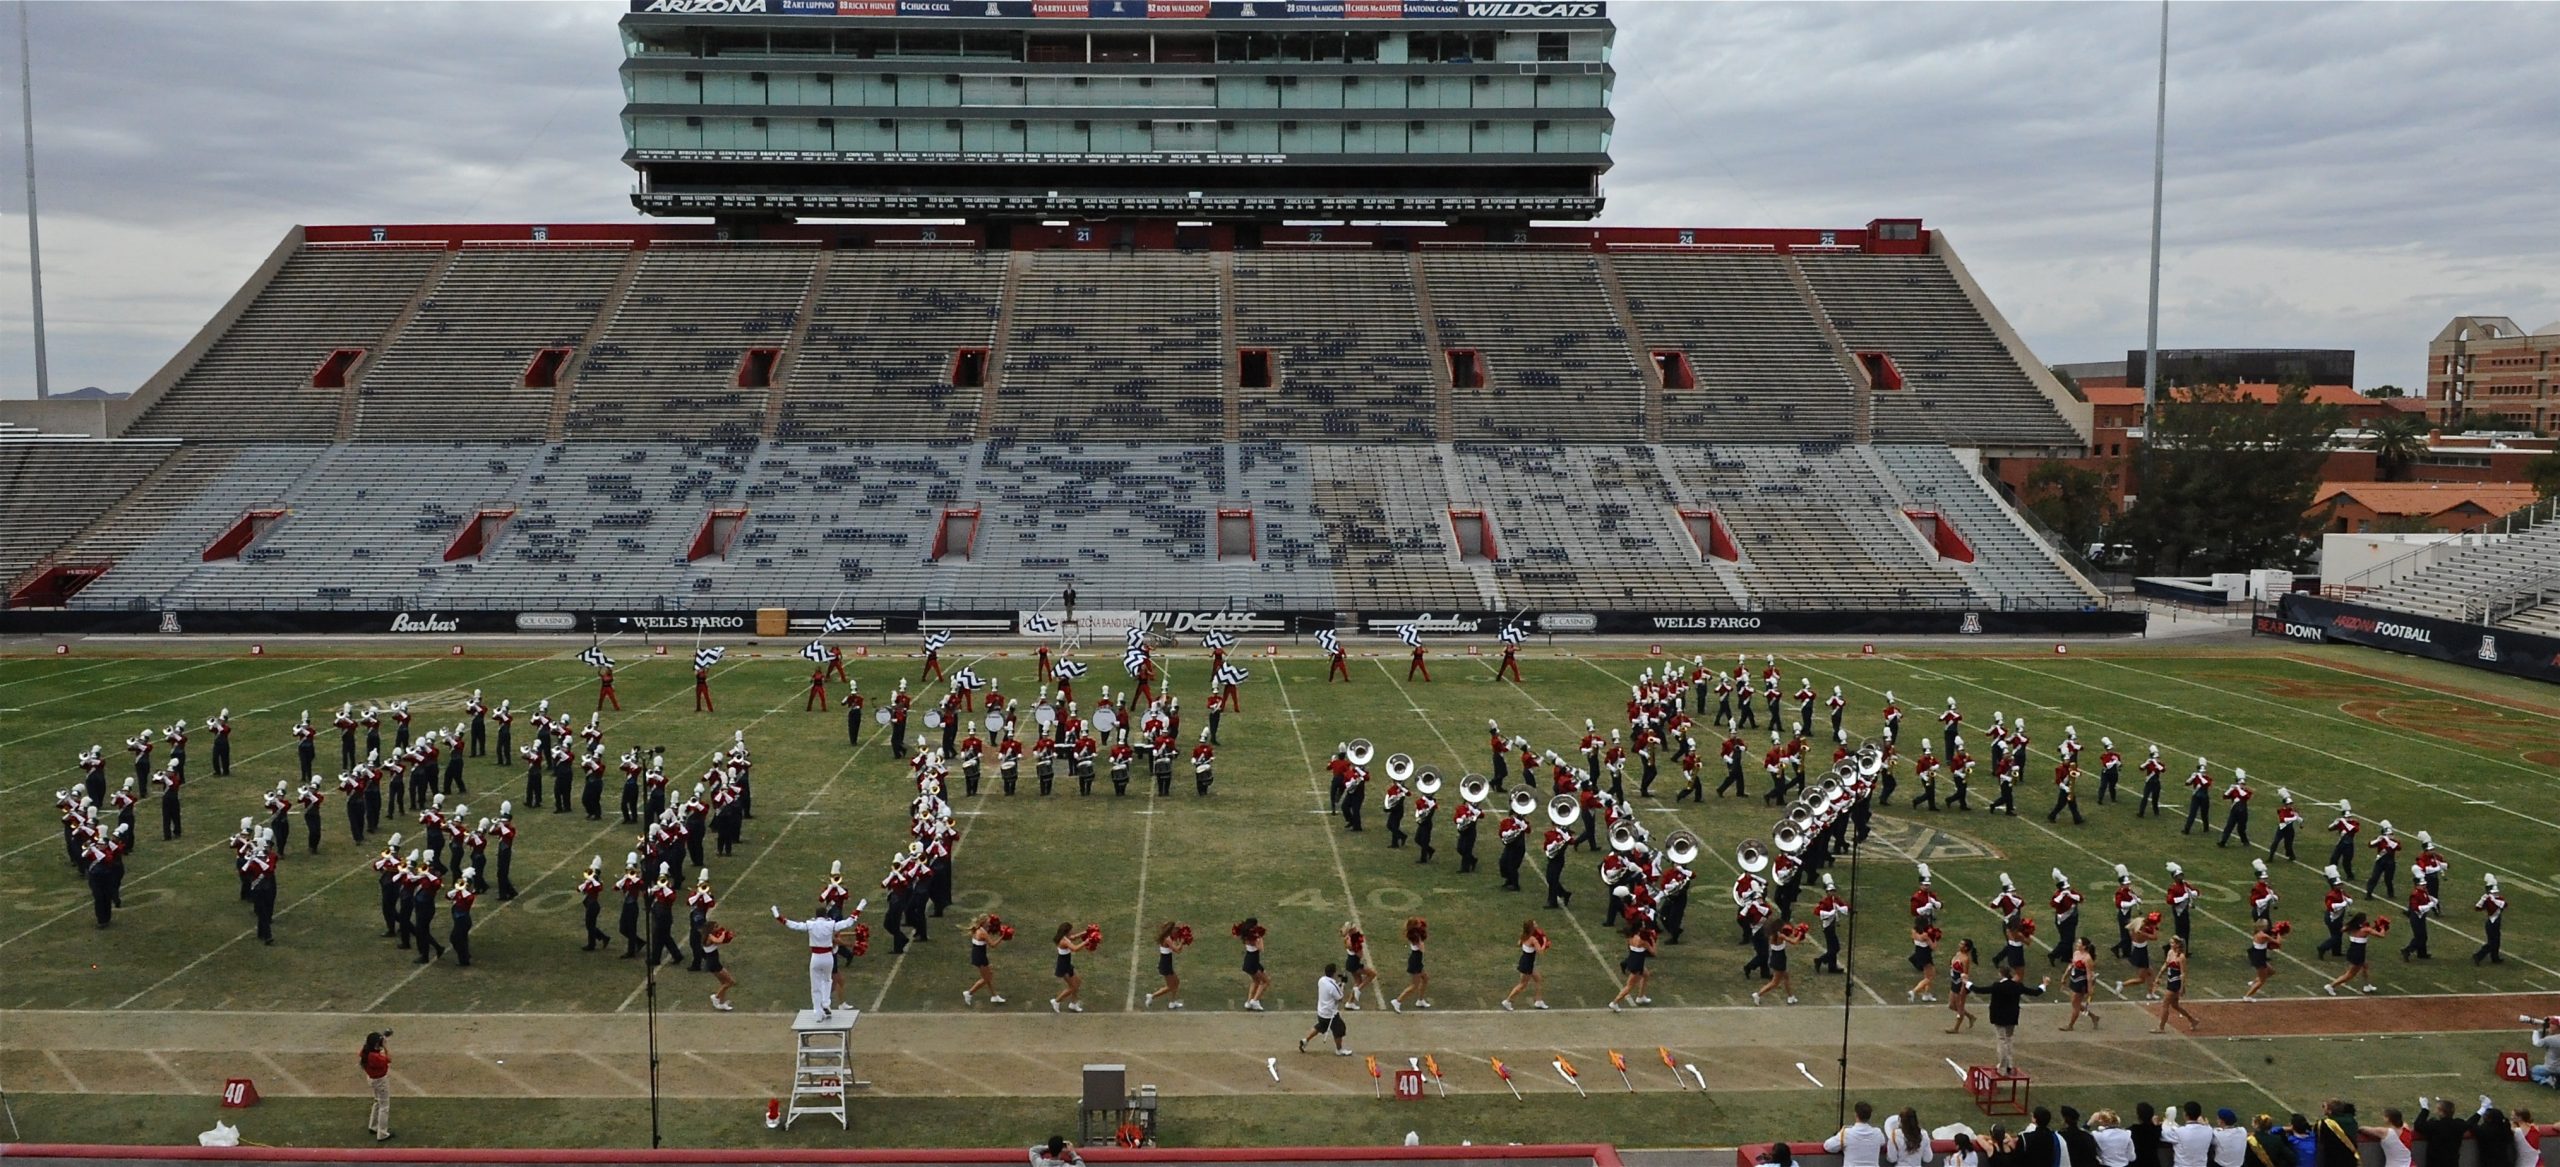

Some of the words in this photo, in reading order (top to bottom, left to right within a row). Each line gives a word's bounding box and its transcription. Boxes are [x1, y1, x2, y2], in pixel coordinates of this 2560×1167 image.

[645, 0, 766, 13] ARIZONA
[792, 1, 806, 9] ART
[806, 1, 835, 9] LUPPINO
[849, 2, 868, 10] RICKY
[870, 2, 896, 10] HUNLEY
[907, 2, 931, 11] CHUCK
[931, 3, 950, 11] CECIL
[1038, 4, 1068, 12] DARRYLL
[1157, 4, 1171, 12] ROB
[1351, 4, 1370, 12] CHRIS
[1408, 4, 1435, 12] ANTOINE
[1436, 4, 1458, 12] CASON
[1467, 3, 1598, 17] WILDCATS
[374, 232, 385, 241] 17
[534, 231, 546, 241] 18
[718, 231, 728, 240] 19
[922, 231, 936, 241] 20
[1077, 231, 1089, 241] 21
[1309, 233, 1322, 242] 22
[1514, 233, 1527, 243] 23
[1680, 235, 1693, 244] 24
[1821, 236, 1835, 245] 25
[390, 613, 459, 632] Bashas'
[633, 616, 687, 628] WELLS
[691, 616, 743, 628] FARGO
[1101, 618, 1121, 628] BAND
[1121, 618, 1137, 628] DAY
[1653, 617, 1706, 628] WELLS
[1709, 617, 1761, 628] FARGO
[2257, 618, 2285, 633] BEAR
[2285, 623, 2322, 640] DOWN
[2333, 615, 2376, 633] ARIZONA
[2374, 621, 2431, 643] FOOTBALL
[1277, 887, 1424, 912] 40
[2506, 1057, 2527, 1077] 20
[1399, 1075, 1419, 1096] 40
[224, 1082, 245, 1104] 40
